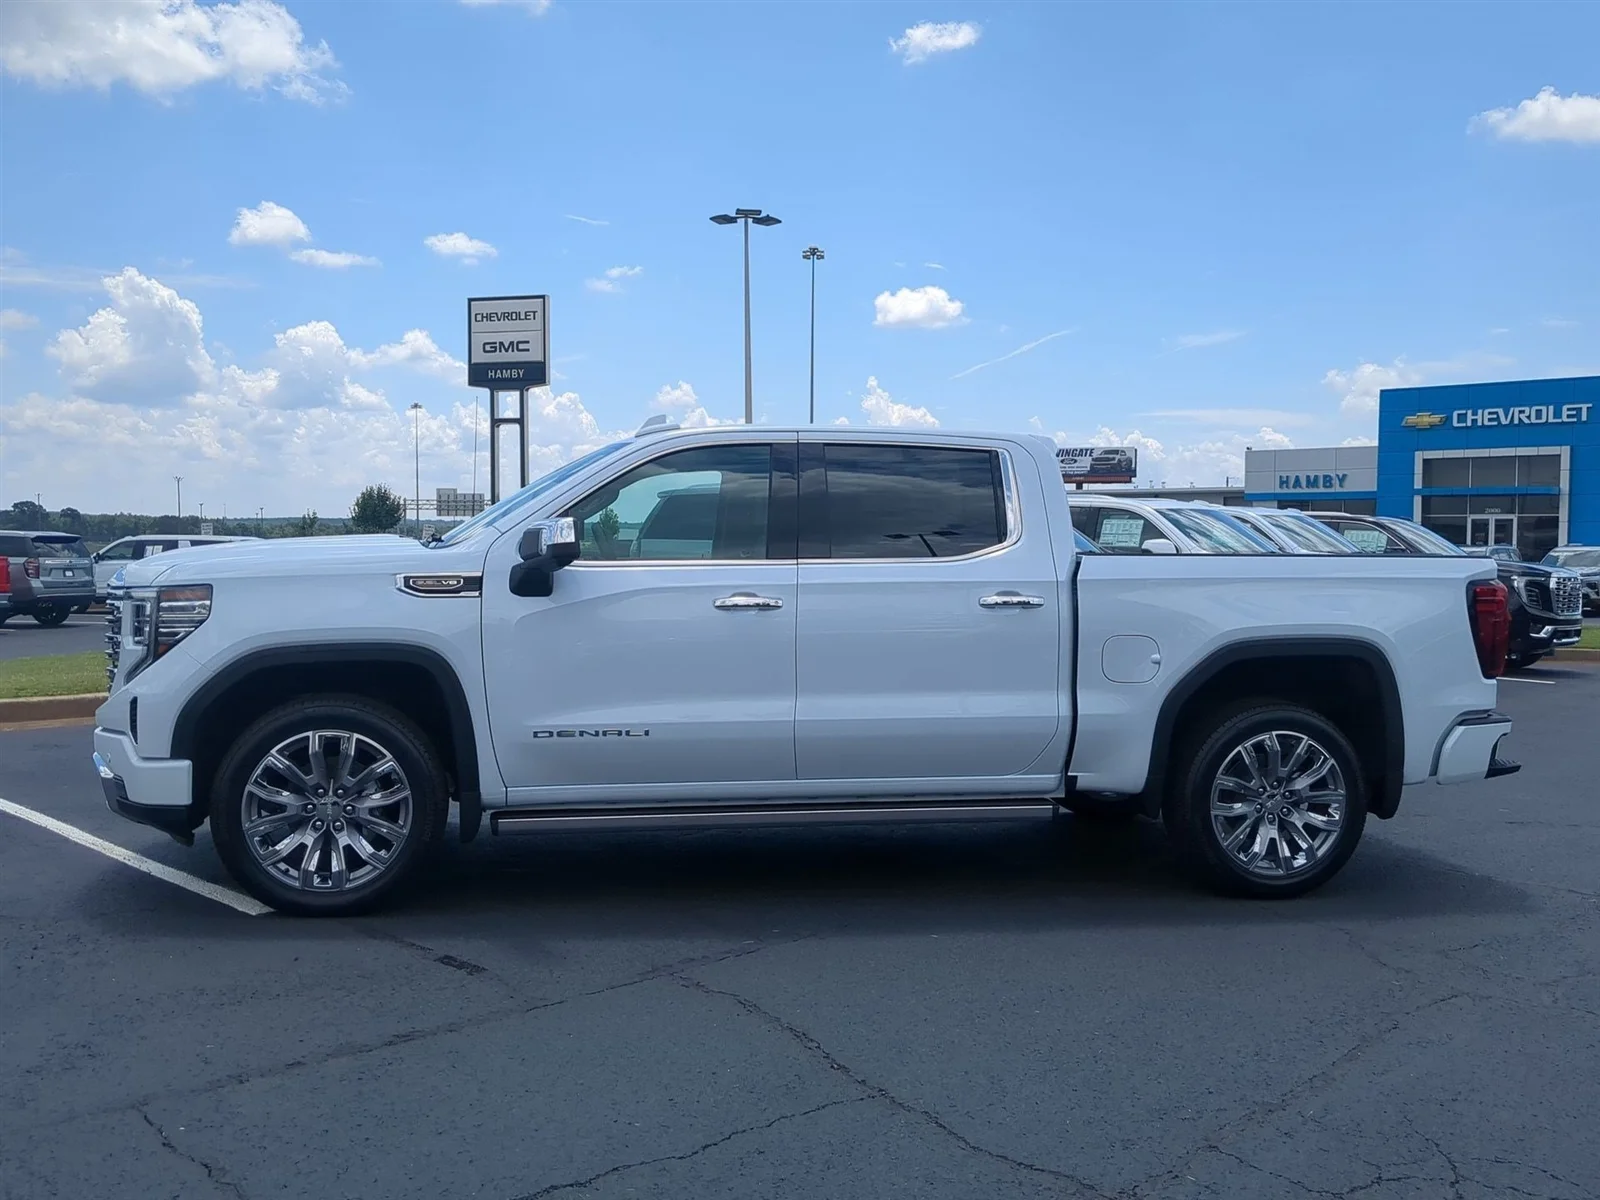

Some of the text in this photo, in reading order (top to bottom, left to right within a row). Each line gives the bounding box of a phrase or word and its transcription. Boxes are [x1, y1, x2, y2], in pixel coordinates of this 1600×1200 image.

[474, 310, 538, 323] CHEVROLET
[482, 340, 530, 353] GMC
[488, 369, 525, 379] HAMBY
[1452, 403, 1593, 427] CHEVROLET
[1279, 473, 1348, 489] HAMBY
[532, 728, 650, 739] DENALI
